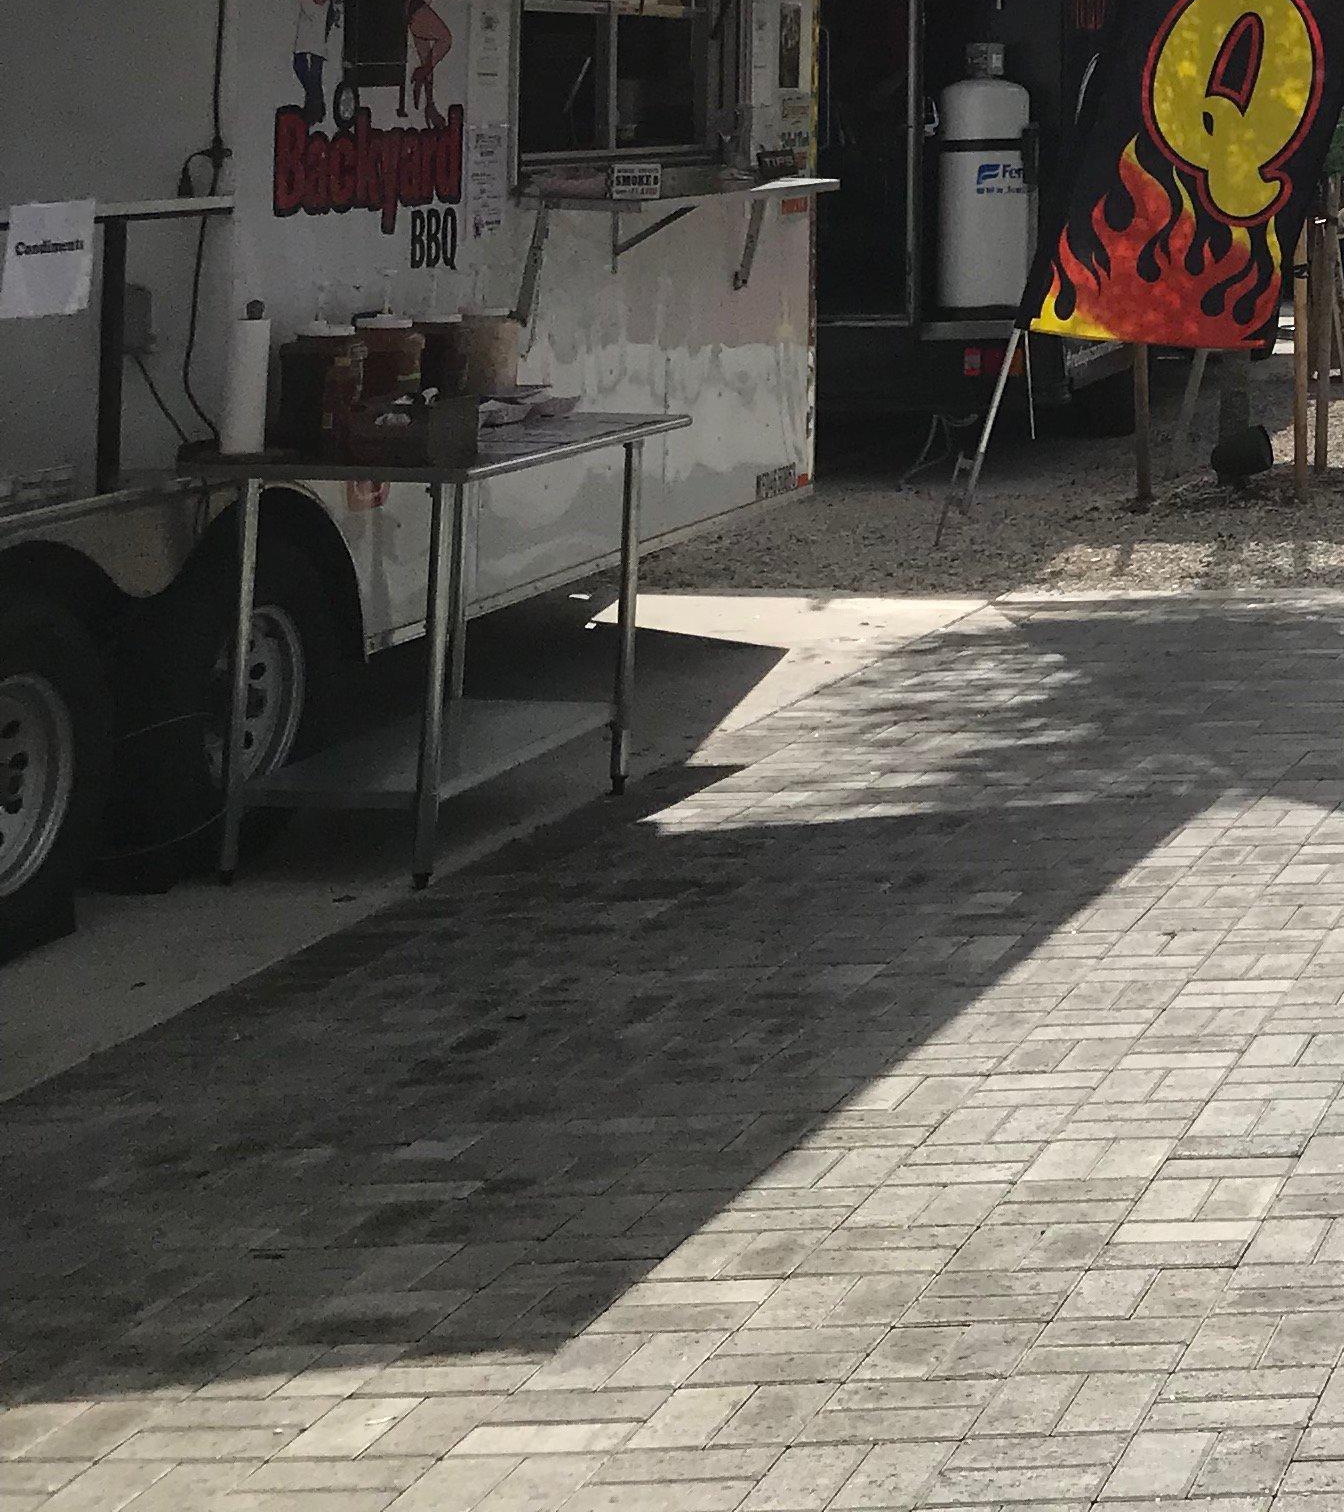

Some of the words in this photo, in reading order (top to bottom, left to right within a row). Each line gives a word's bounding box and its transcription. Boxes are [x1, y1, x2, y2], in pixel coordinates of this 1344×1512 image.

[273, 104, 464, 234] Backyard
[14, 239, 84, 256] Condiments
[409, 204, 458, 270] BBQ
